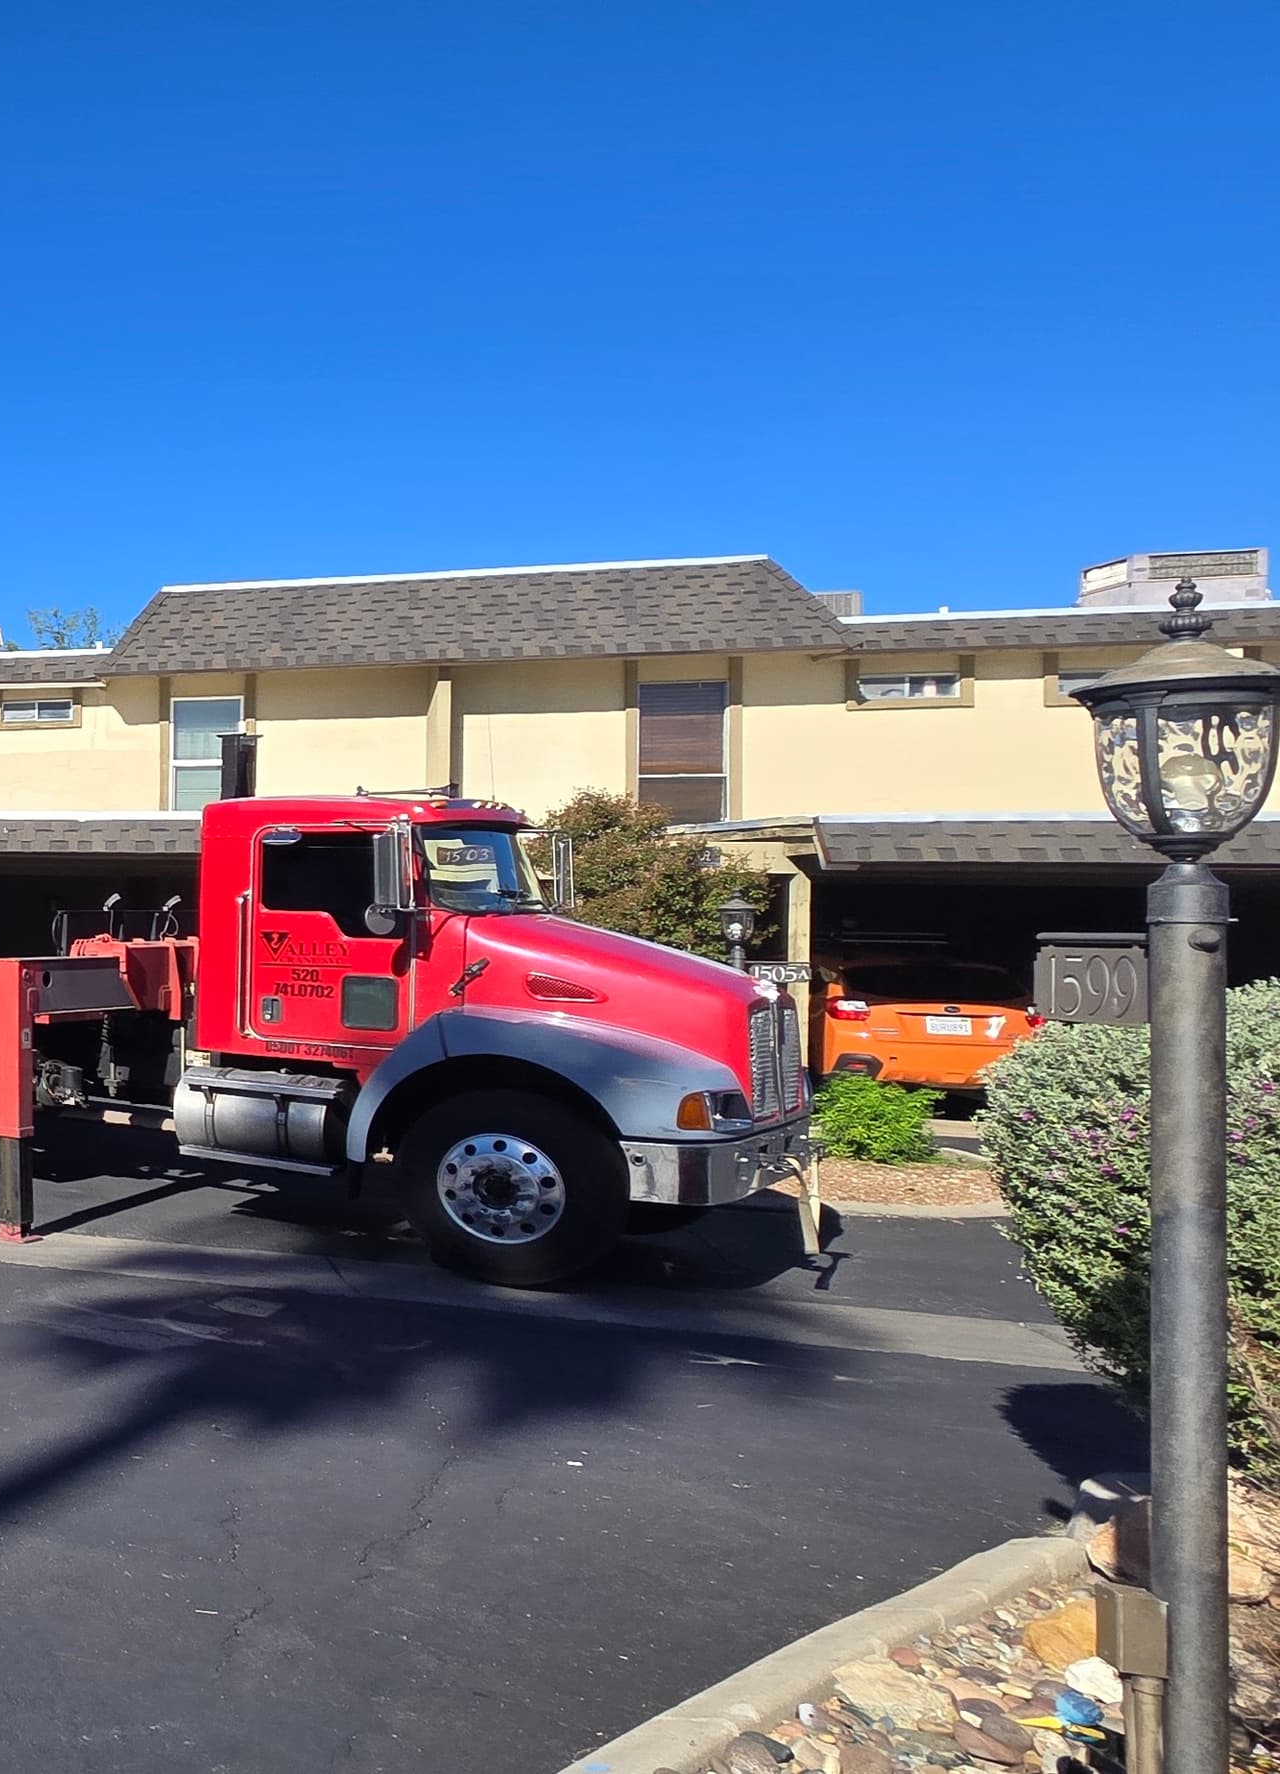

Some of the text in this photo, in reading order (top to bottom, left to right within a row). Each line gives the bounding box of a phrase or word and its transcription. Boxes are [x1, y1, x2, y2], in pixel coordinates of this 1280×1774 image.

[445, 848, 489, 862] 1503
[260, 931, 350, 961] VALLEY
[754, 966, 809, 982] 1505A
[1049, 955, 1137, 1018] 1599
